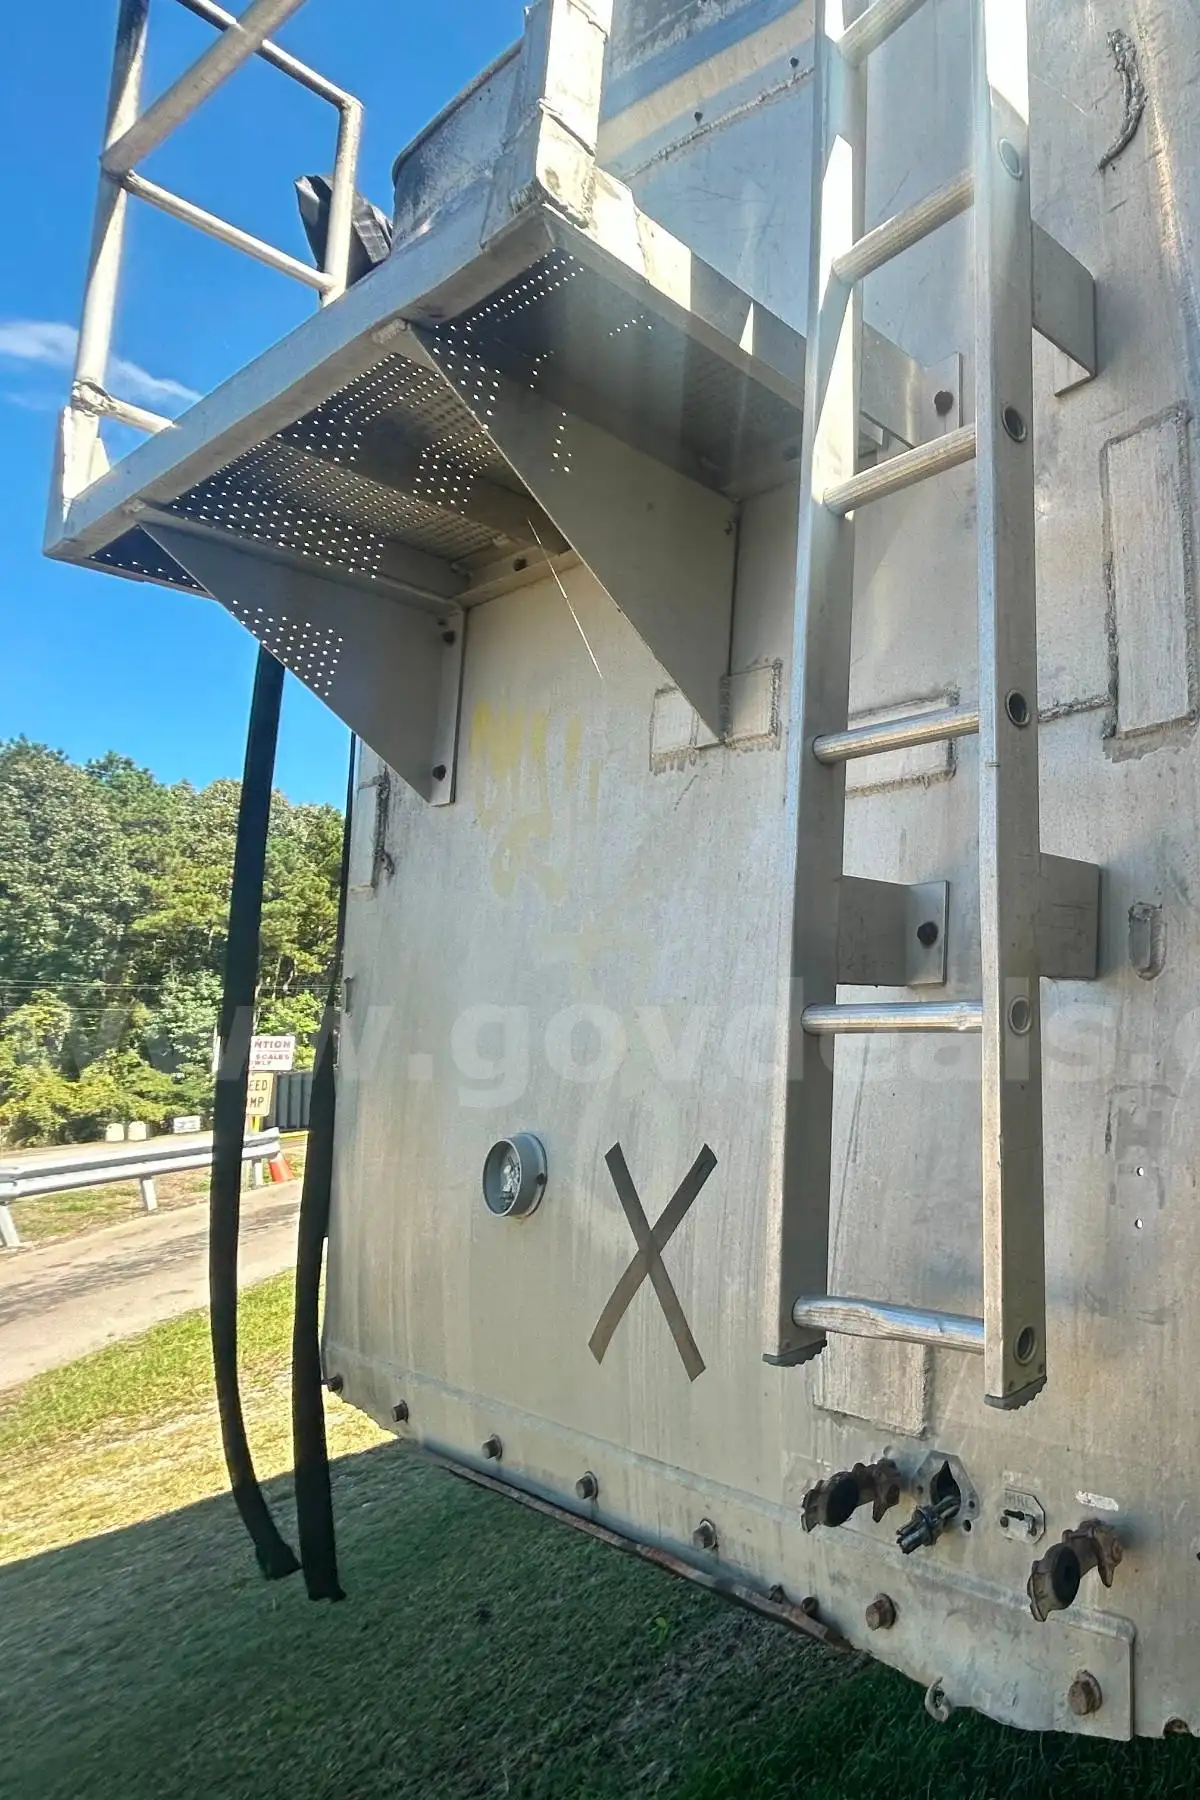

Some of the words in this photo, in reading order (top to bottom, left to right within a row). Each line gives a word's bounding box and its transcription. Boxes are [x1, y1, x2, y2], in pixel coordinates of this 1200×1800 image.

[254, 1040, 291, 1049] NTION
[248, 1080, 268, 1092] EED
[249, 1097, 265, 1109] MP
